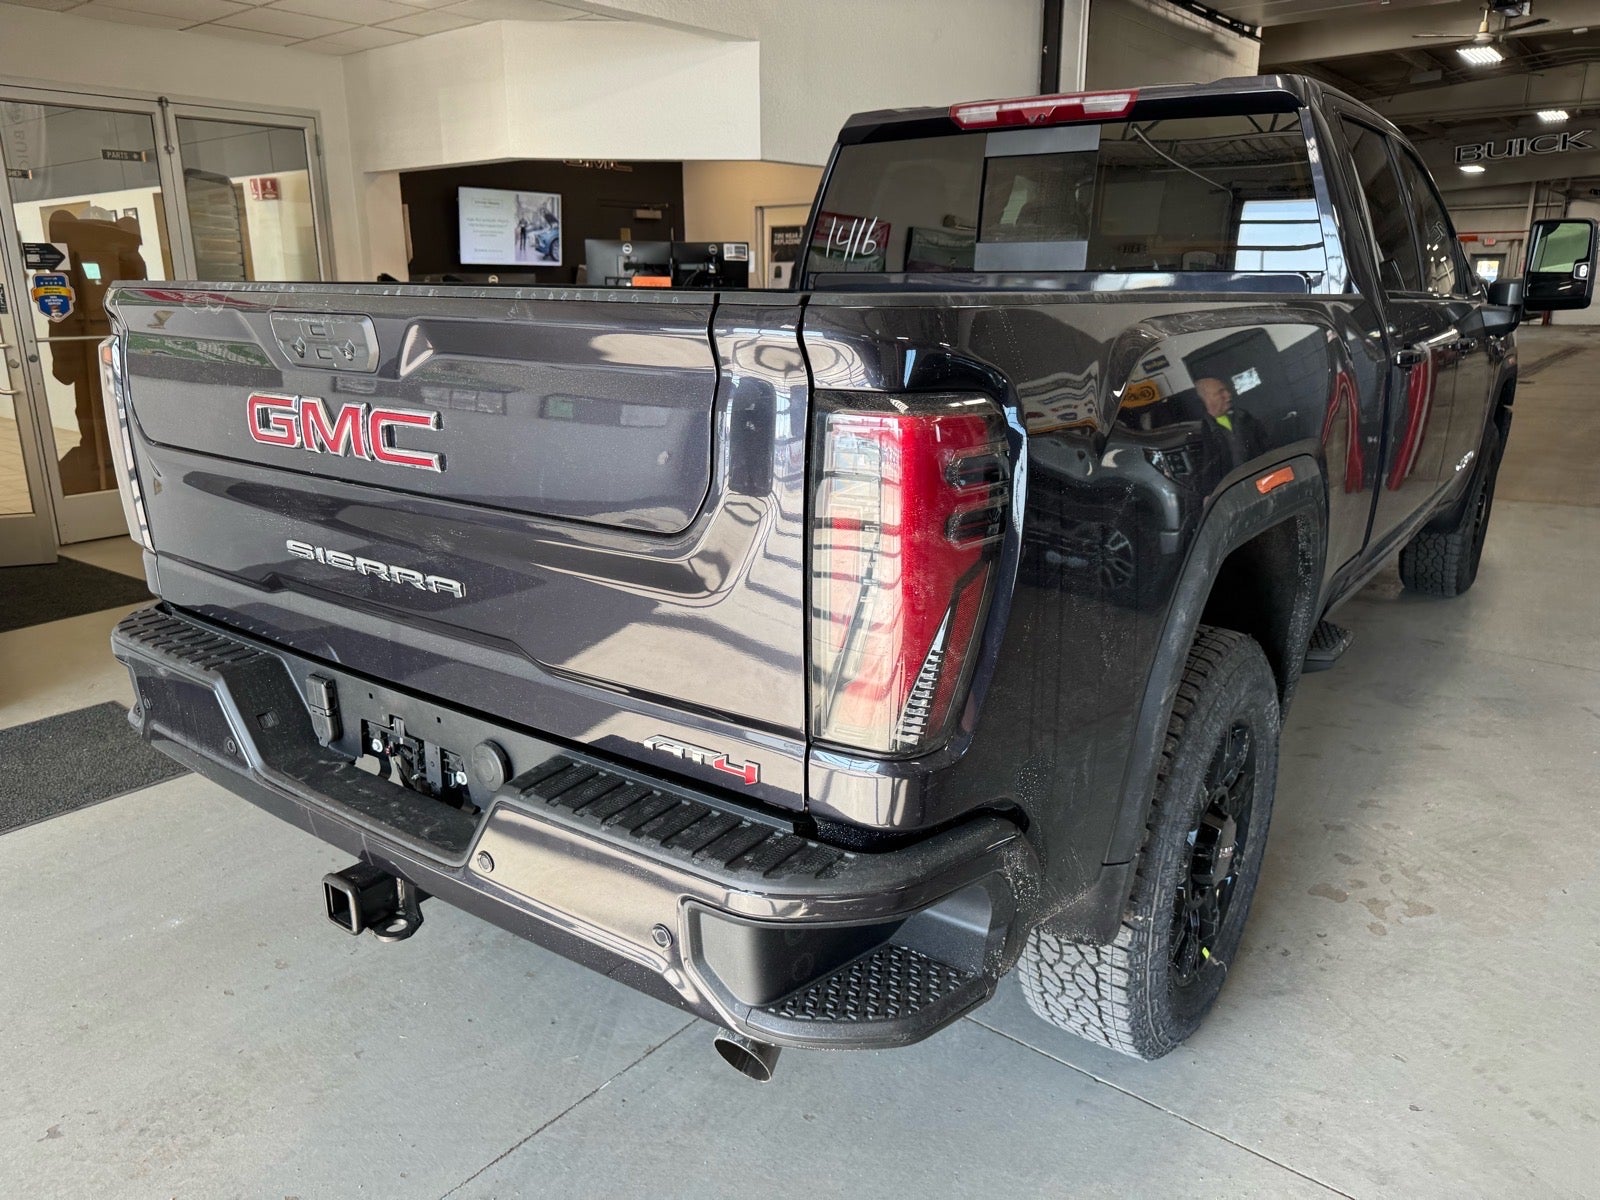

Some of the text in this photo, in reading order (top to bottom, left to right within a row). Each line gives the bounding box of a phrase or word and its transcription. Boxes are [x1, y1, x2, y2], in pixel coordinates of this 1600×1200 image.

[1455, 130, 1592, 163] BUICK
[826, 216, 878, 262] 1416
[247, 391, 447, 473] GMC
[286, 539, 467, 598] SIERRA
[643, 734, 761, 785] AT4
